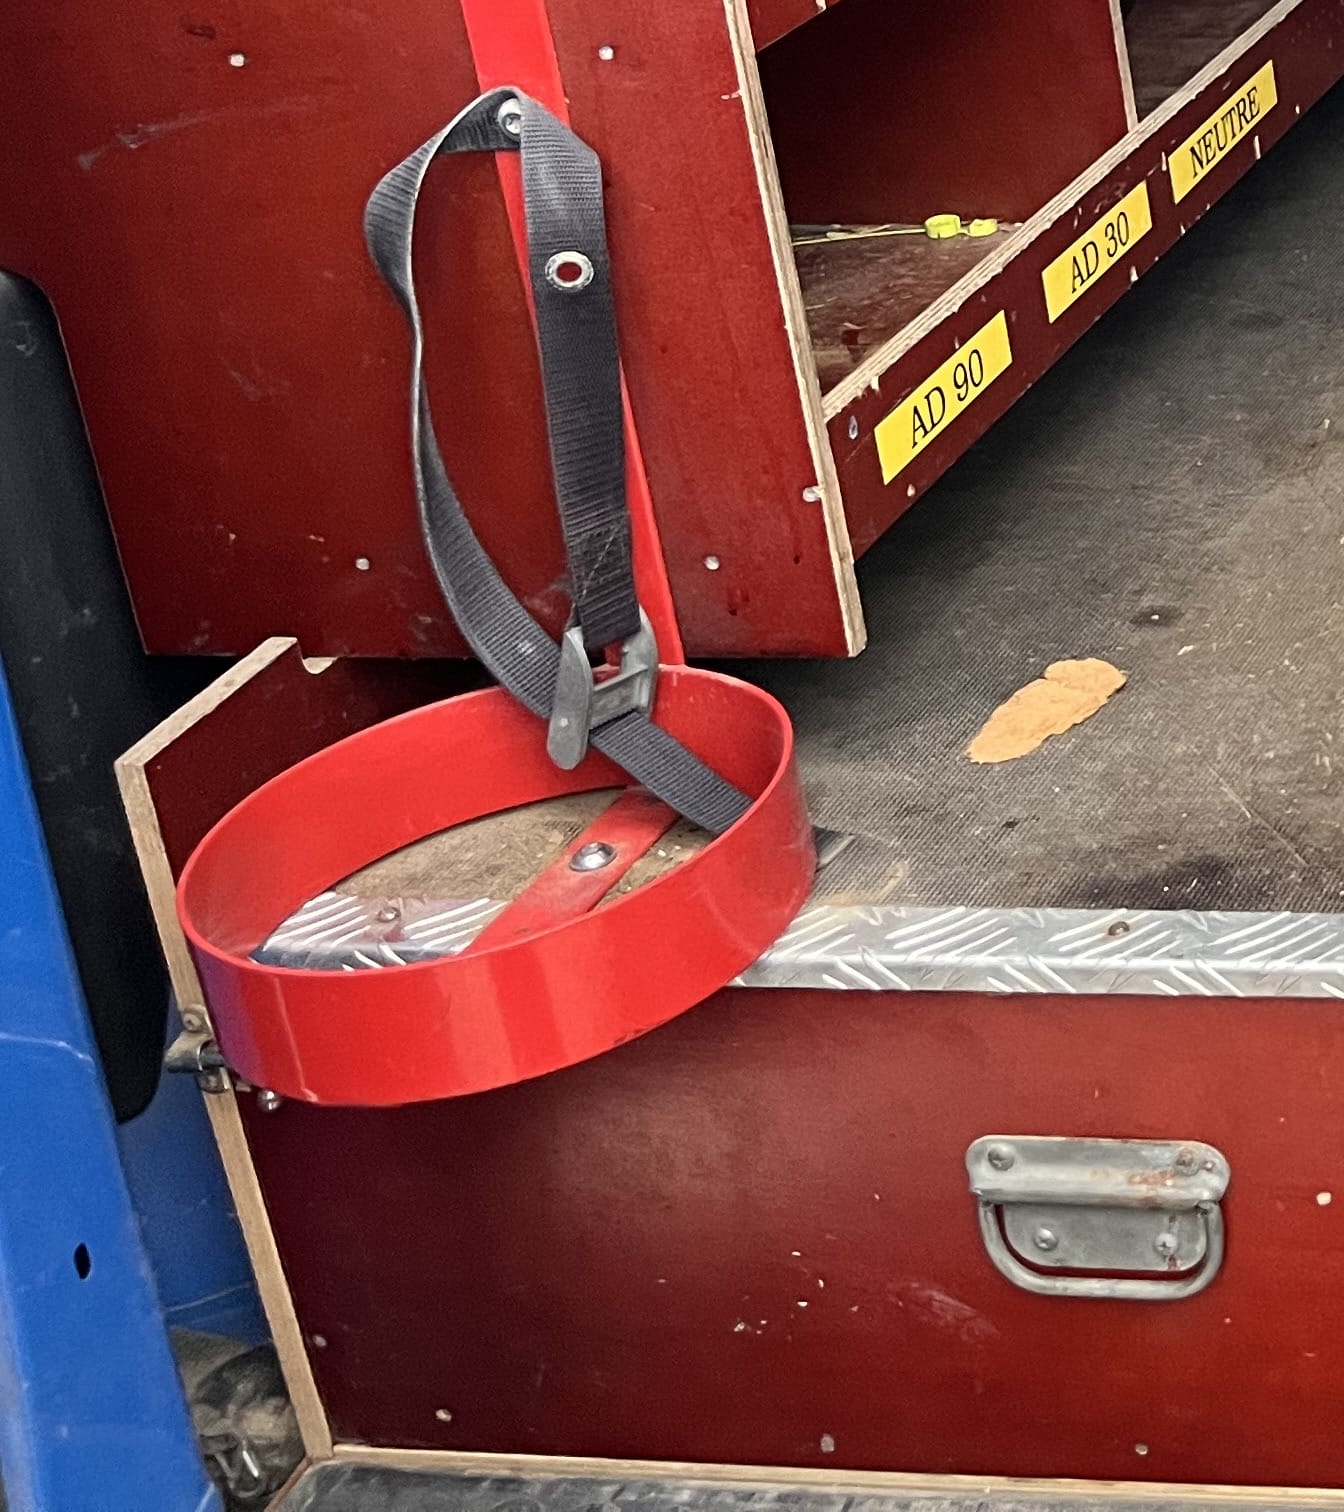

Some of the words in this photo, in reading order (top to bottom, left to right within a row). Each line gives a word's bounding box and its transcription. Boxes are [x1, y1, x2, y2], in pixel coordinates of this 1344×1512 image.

[1190, 86, 1260, 178] NEUTRE
[1071, 240, 1099, 294] AD
[1104, 211, 1129, 259] 30
[911, 386, 946, 449] AD
[953, 348, 984, 402] 90
